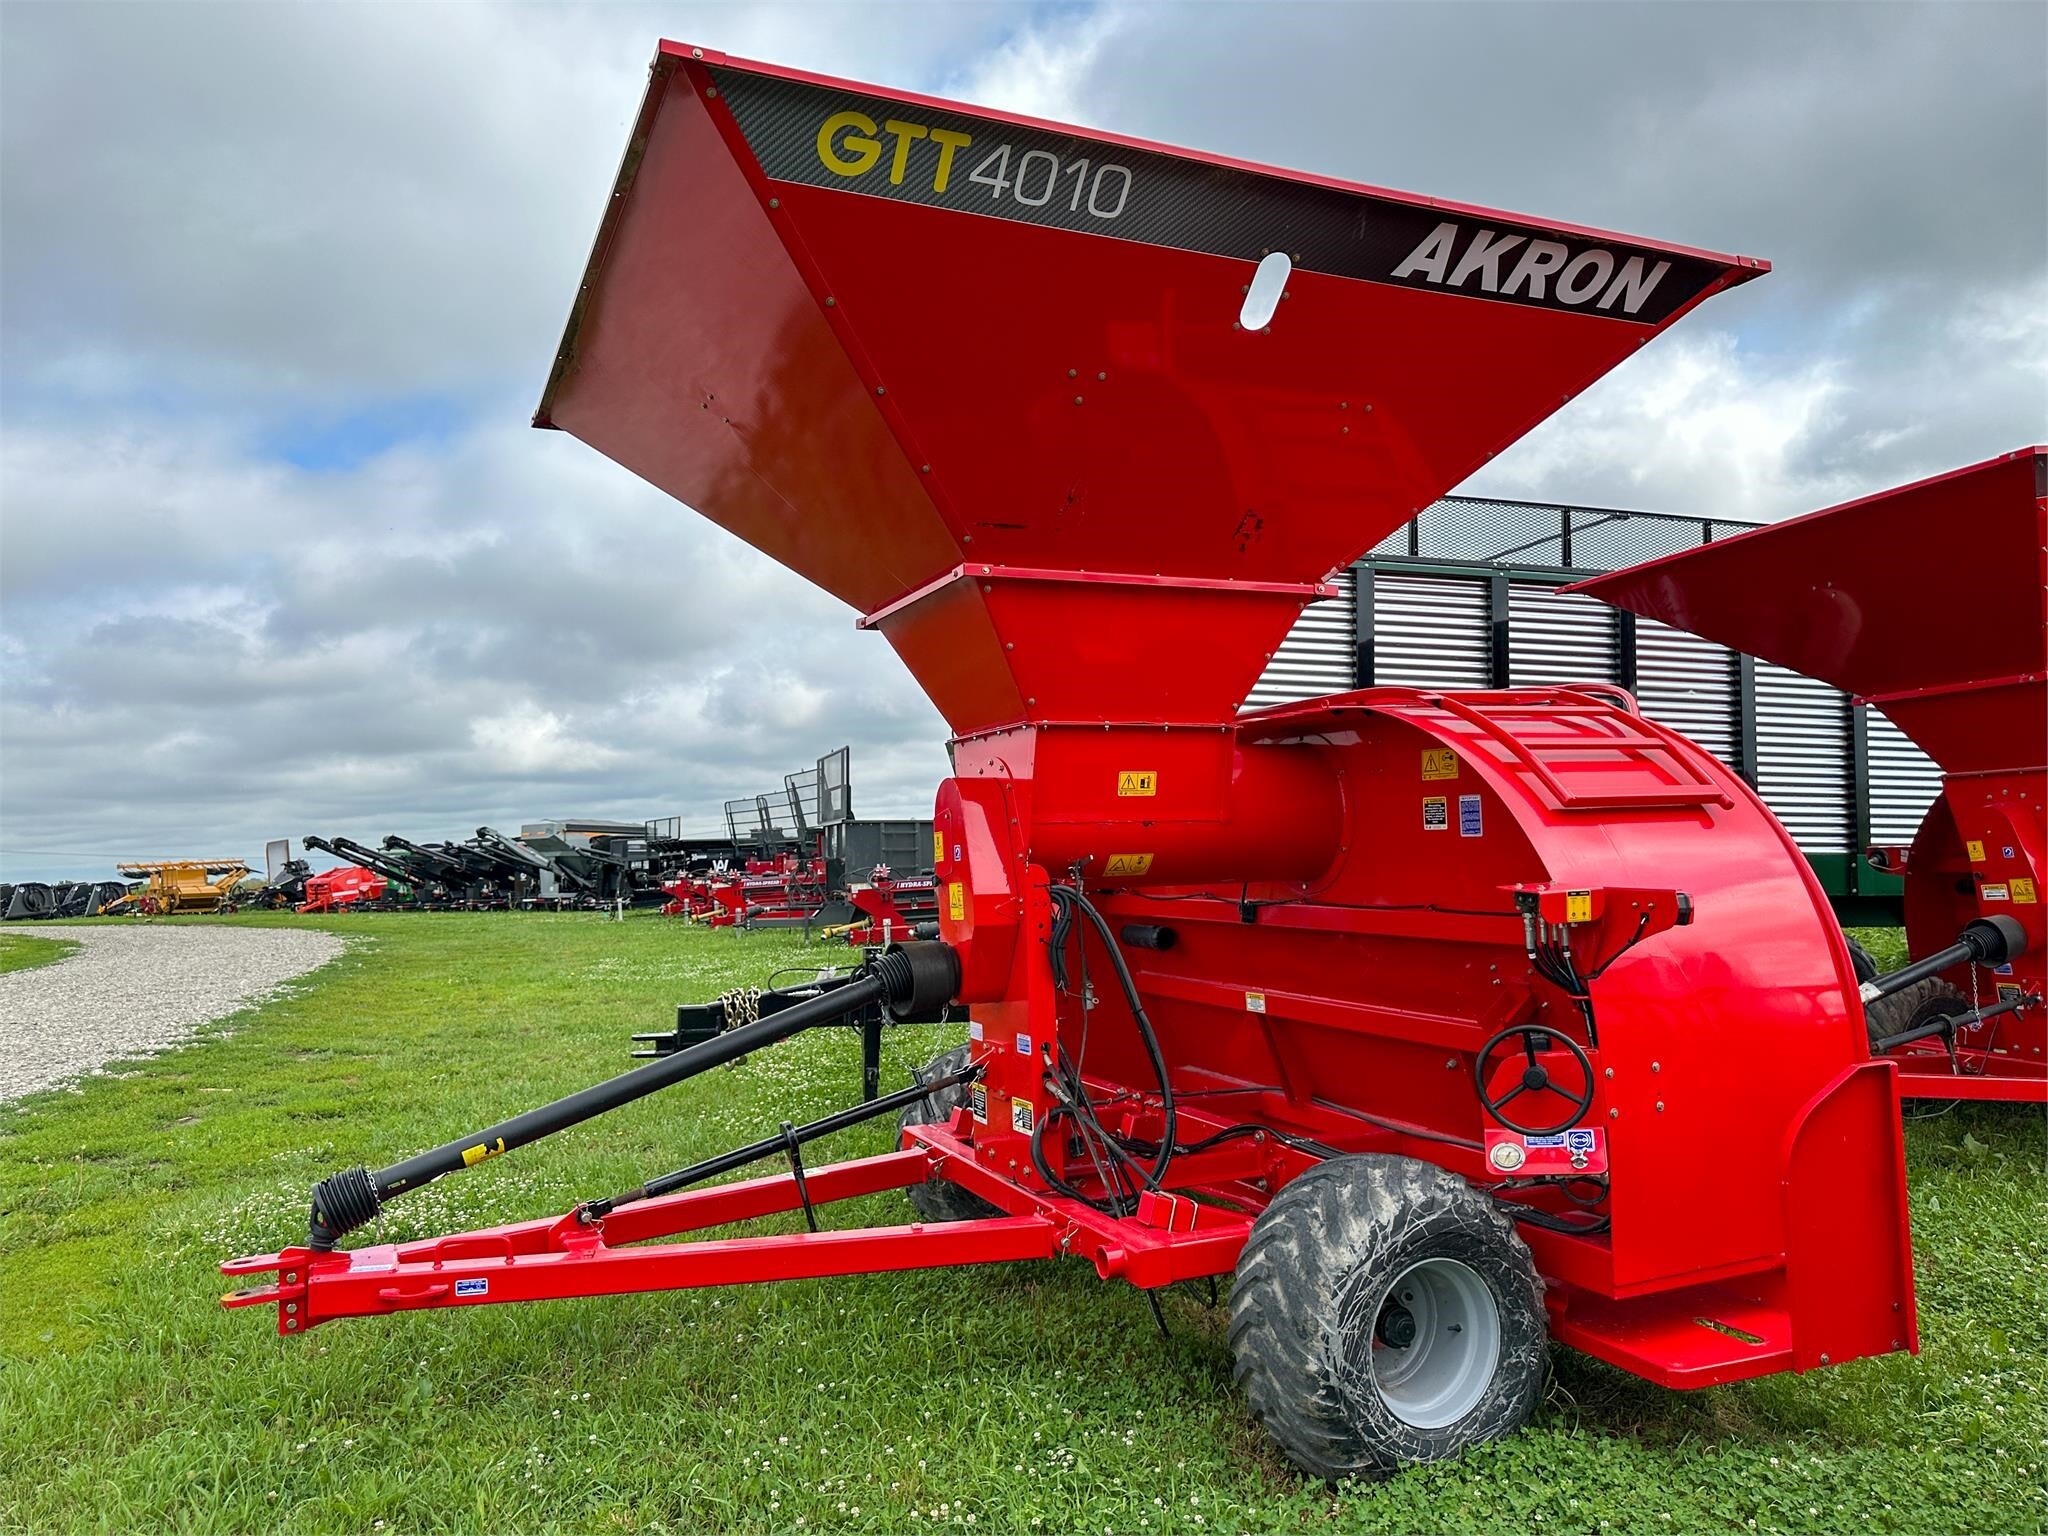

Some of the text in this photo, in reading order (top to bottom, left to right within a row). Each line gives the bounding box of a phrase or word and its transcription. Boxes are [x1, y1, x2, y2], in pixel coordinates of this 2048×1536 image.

[817, 111, 1133, 219] GTT 4010
[1390, 222, 1672, 314] AKRON
